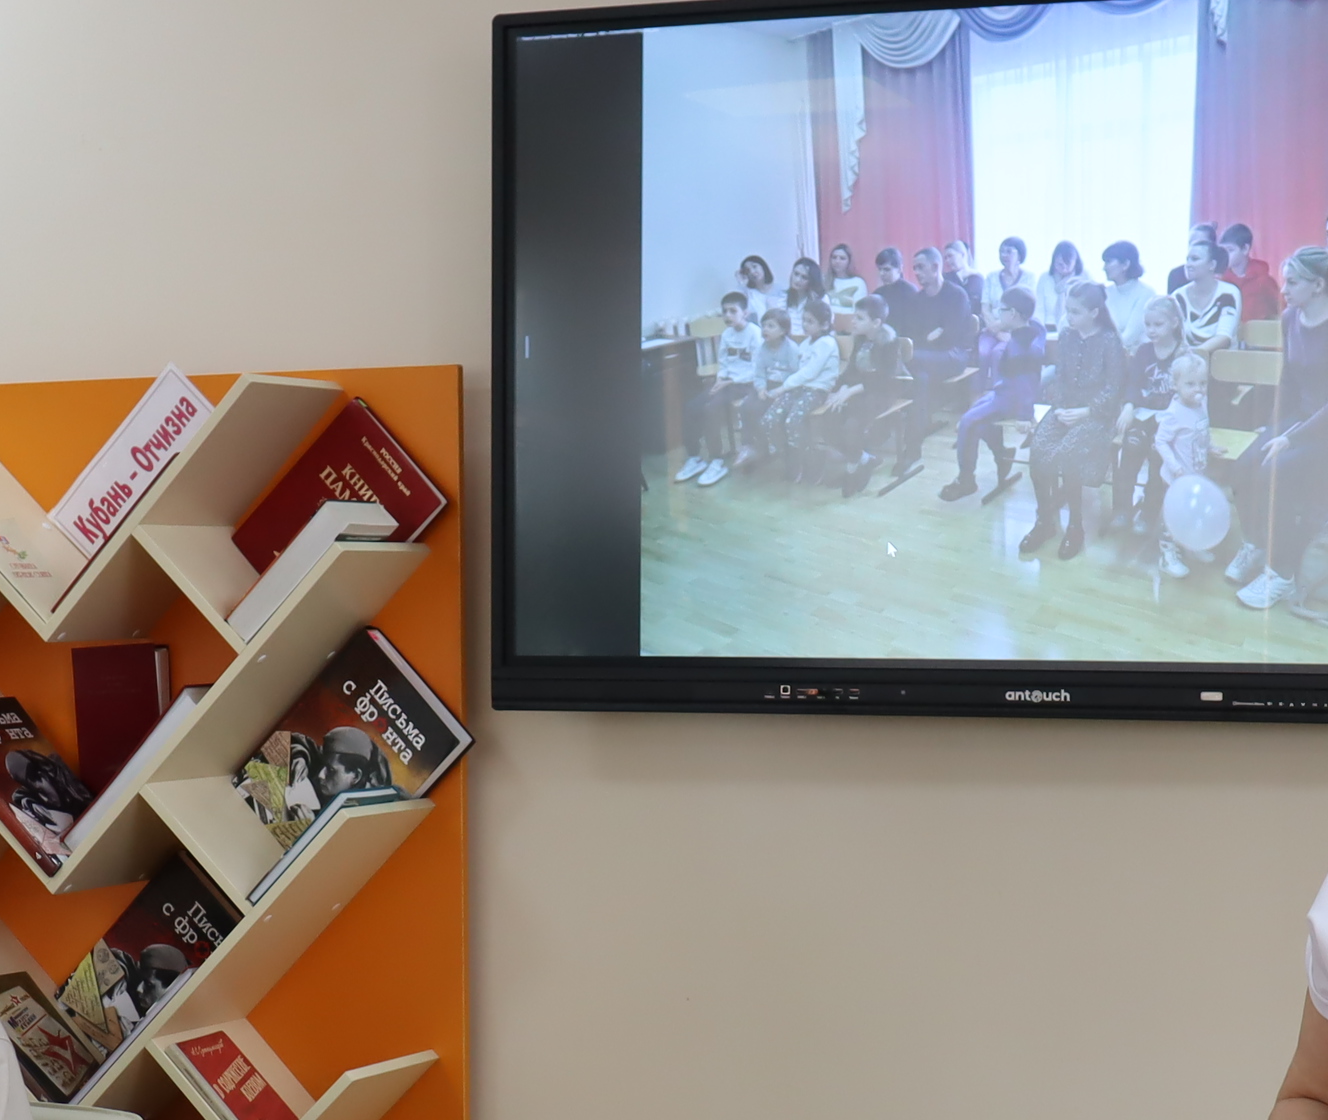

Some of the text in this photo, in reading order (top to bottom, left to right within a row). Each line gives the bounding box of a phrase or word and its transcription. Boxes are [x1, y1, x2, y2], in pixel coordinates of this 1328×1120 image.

[73, 481, 133, 544] Кубань
[131, 397, 198, 472] Отчизна
[343, 681, 356, 695] с
[370, 680, 426, 750] Письма
[163, 903, 175, 916] с
